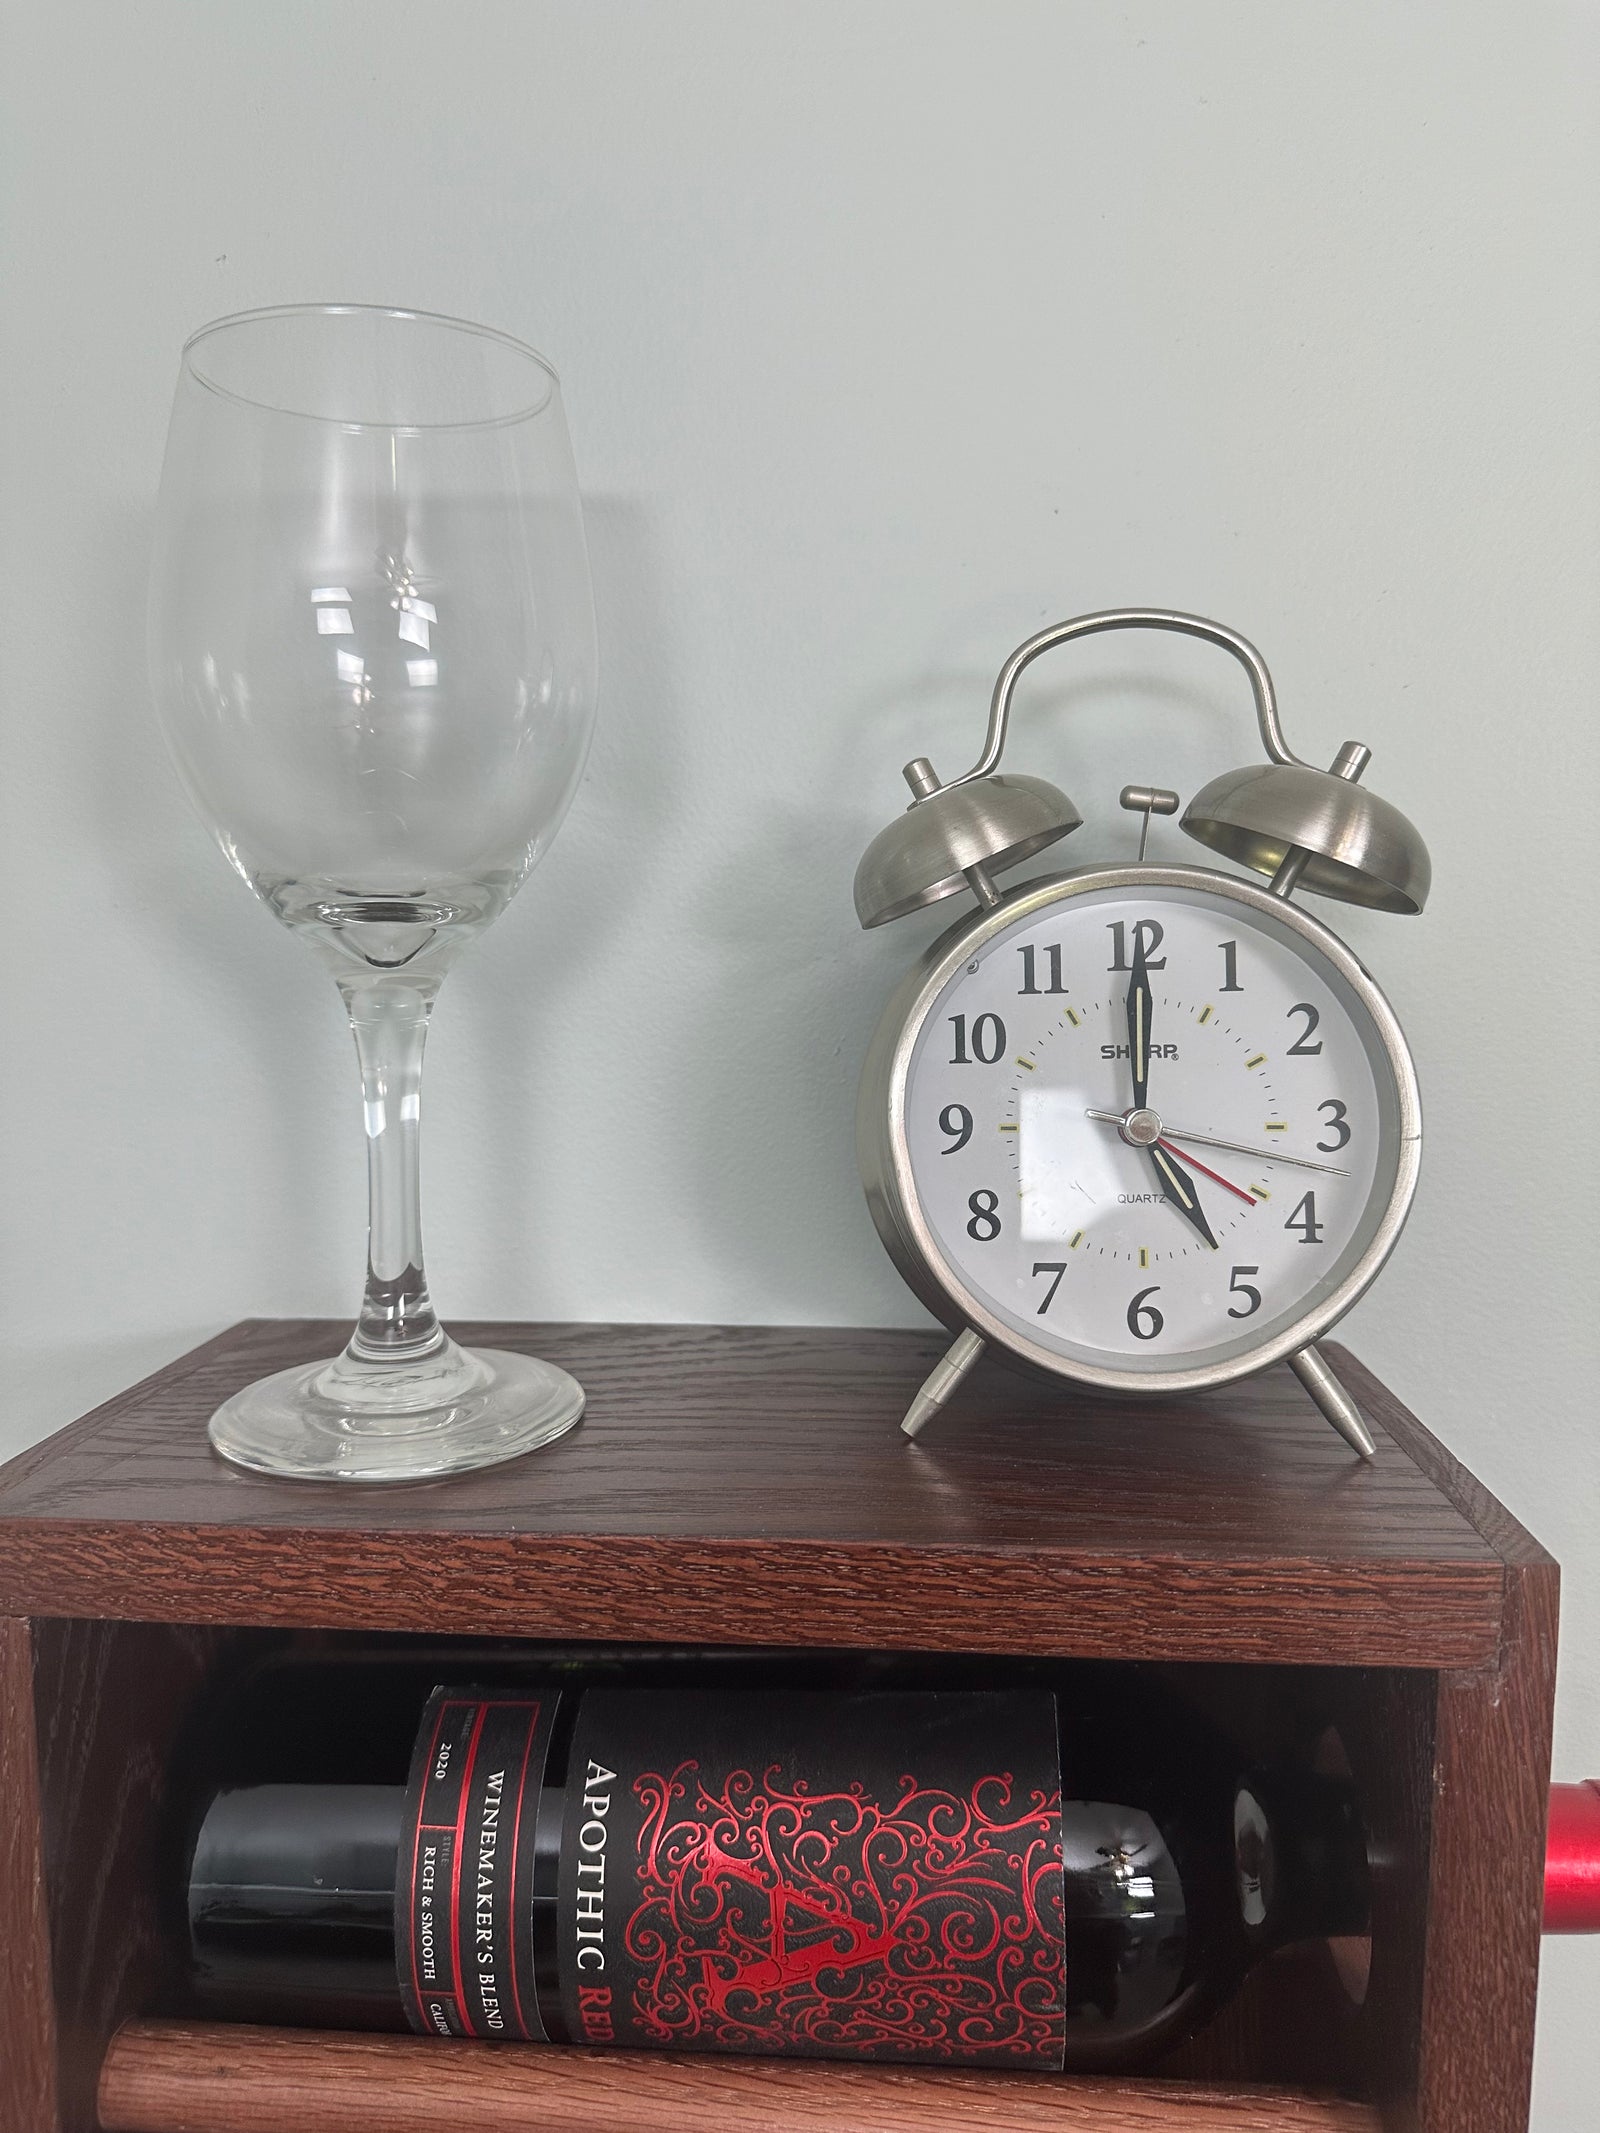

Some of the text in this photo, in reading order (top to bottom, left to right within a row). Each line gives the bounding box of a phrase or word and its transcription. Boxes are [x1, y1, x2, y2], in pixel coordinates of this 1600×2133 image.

[1016, 943, 1070, 995] 11
[1105, 918, 1168, 972] 12
[1217, 940, 1245, 992] 1
[947, 1012, 1007, 1065] 10
[1100, 1043, 1178, 1060] SHRP
[1286, 1002, 1323, 1056] 2
[938, 1103, 974, 1156] 9
[1316, 1099, 1352, 1153] 3
[966, 1189, 1002, 1242] 8
[1117, 1193, 1167, 1204] QUARTZ
[1284, 1190, 1324, 1244] 4
[1031, 1262, 1068, 1315] 7
[1126, 1286, 1164, 1340] 6
[1227, 1265, 1262, 1319] 5
[434, 1742, 452, 1780] 2020
[421, 1846, 437, 1980] RICH & SMOOTH
[476, 1769, 505, 2029] WINEMAKER'S BLEND
[576, 1758, 618, 2041] APOTHIC RED
